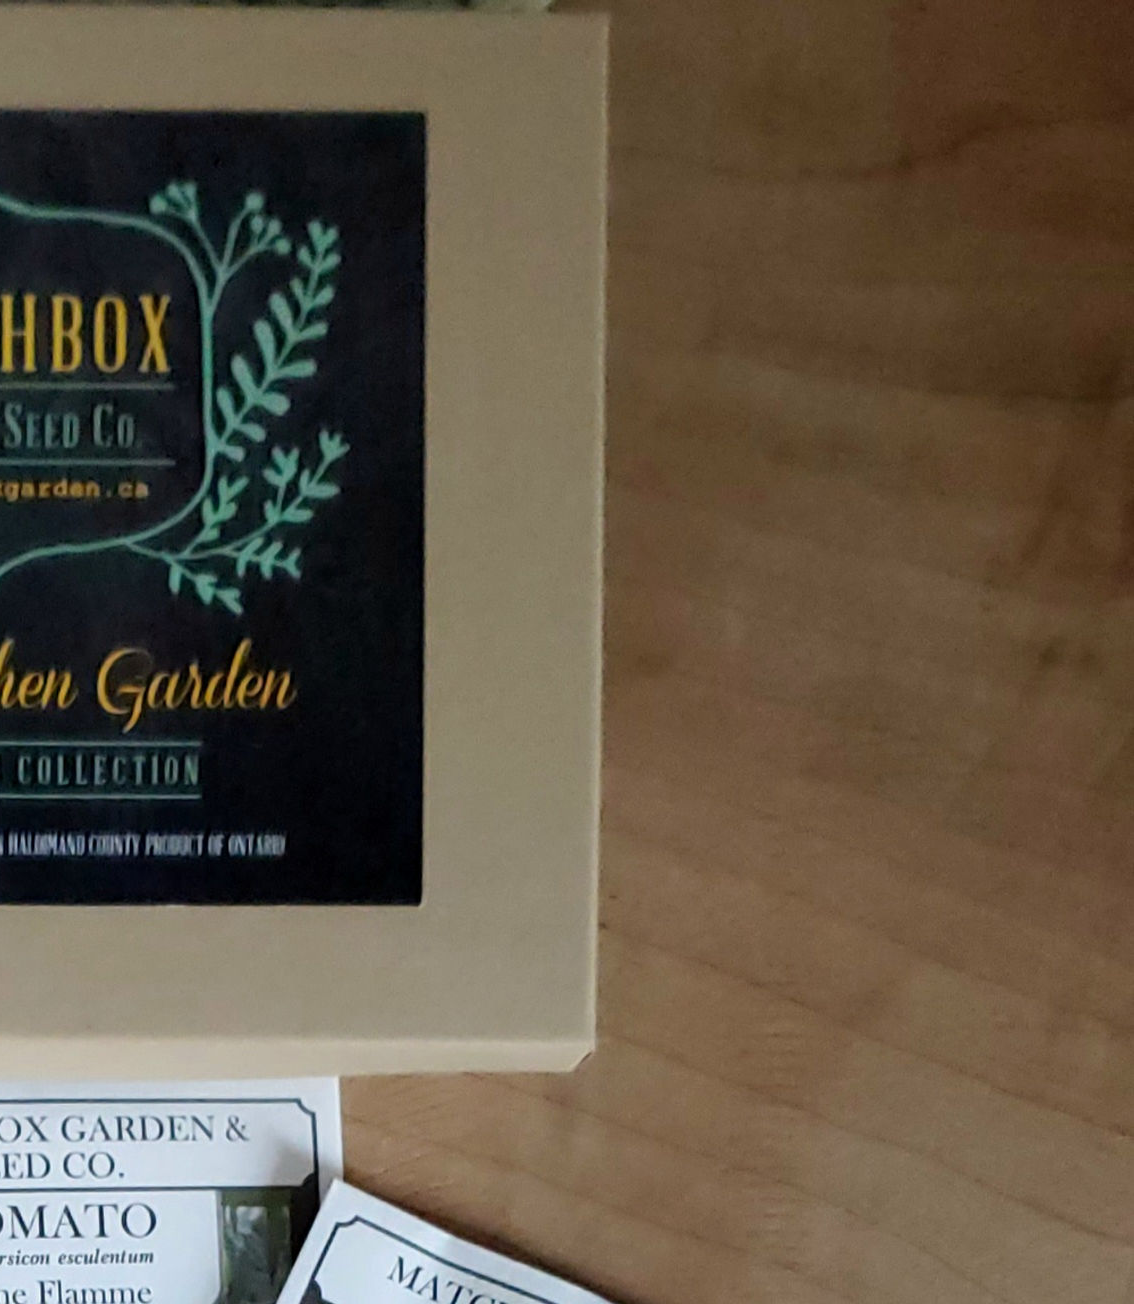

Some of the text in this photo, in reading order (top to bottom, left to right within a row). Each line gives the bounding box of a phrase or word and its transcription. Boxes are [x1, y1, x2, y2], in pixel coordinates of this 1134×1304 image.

[96, 637, 298, 733] Garden
[17, 754, 201, 787] COLLECTION
[88, 833, 141, 857] COUNTY
[144, 833, 204, 857] PRODUCT
[207, 834, 226, 857] OF
[61, 1114, 217, 1143] GARDEN
[225, 1116, 250, 1143] &
[63, 1151, 126, 1180] CO.
[58, 1247, 155, 1267] esculentum
